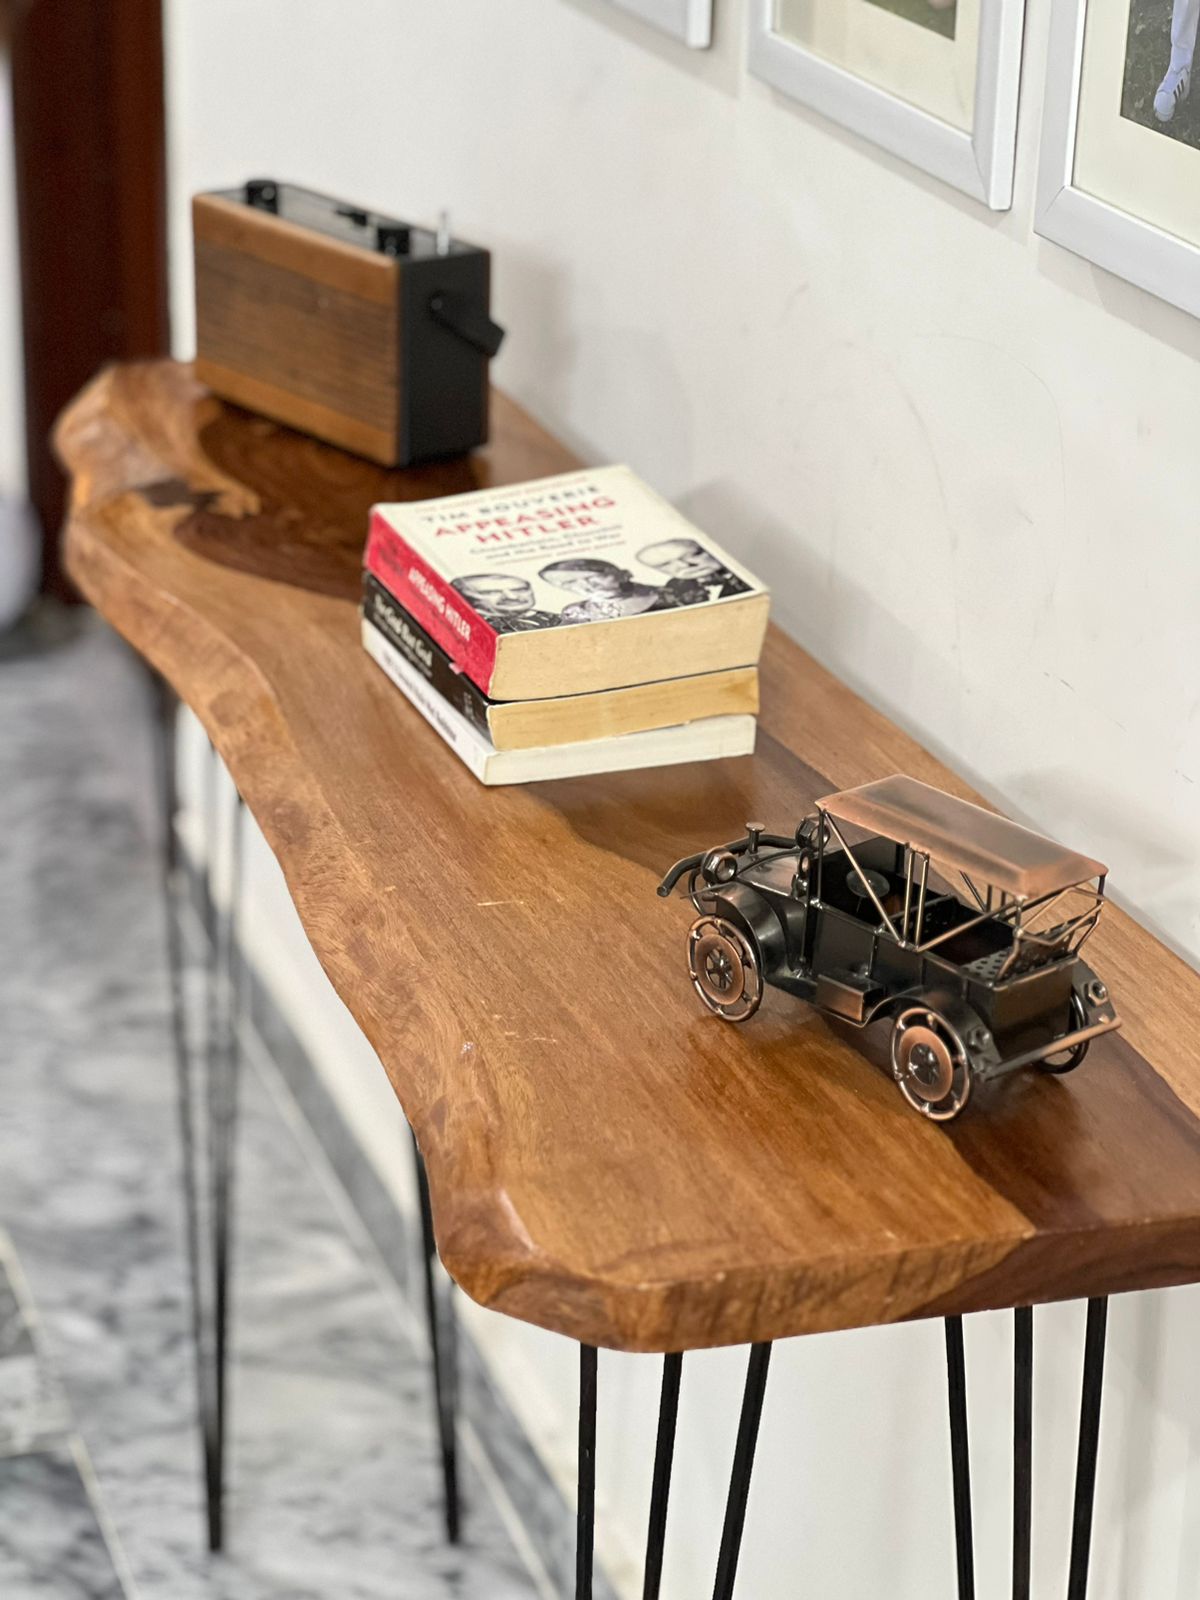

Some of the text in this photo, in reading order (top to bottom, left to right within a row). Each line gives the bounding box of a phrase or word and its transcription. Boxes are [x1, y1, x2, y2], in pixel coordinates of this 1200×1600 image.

[434, 496, 617, 537] APPEASING
[475, 515, 601, 544] HITLER
[408, 566, 446, 615] APPEASING
[445, 603, 471, 642] HITLER
